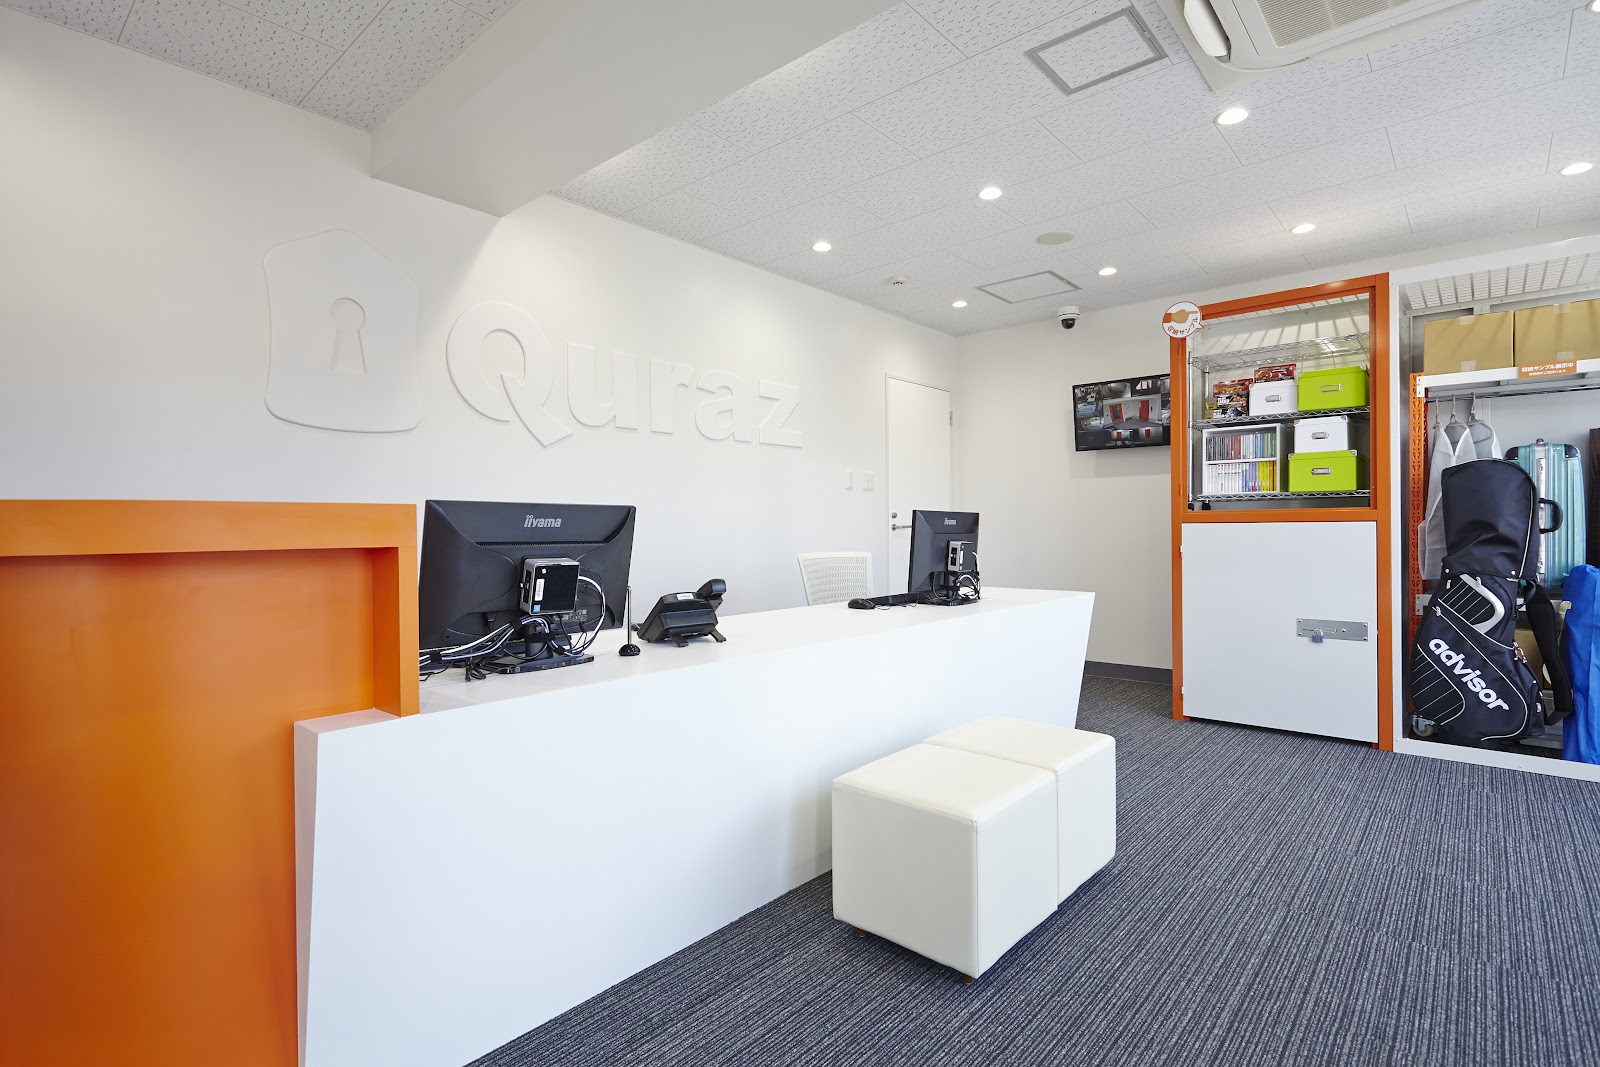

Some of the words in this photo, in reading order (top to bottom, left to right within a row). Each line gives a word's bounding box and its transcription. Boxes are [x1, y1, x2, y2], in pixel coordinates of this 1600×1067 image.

[446, 301, 802, 448] Quraz
[523, 514, 562, 528] iiyama
[1428, 638, 1510, 711] advisor
